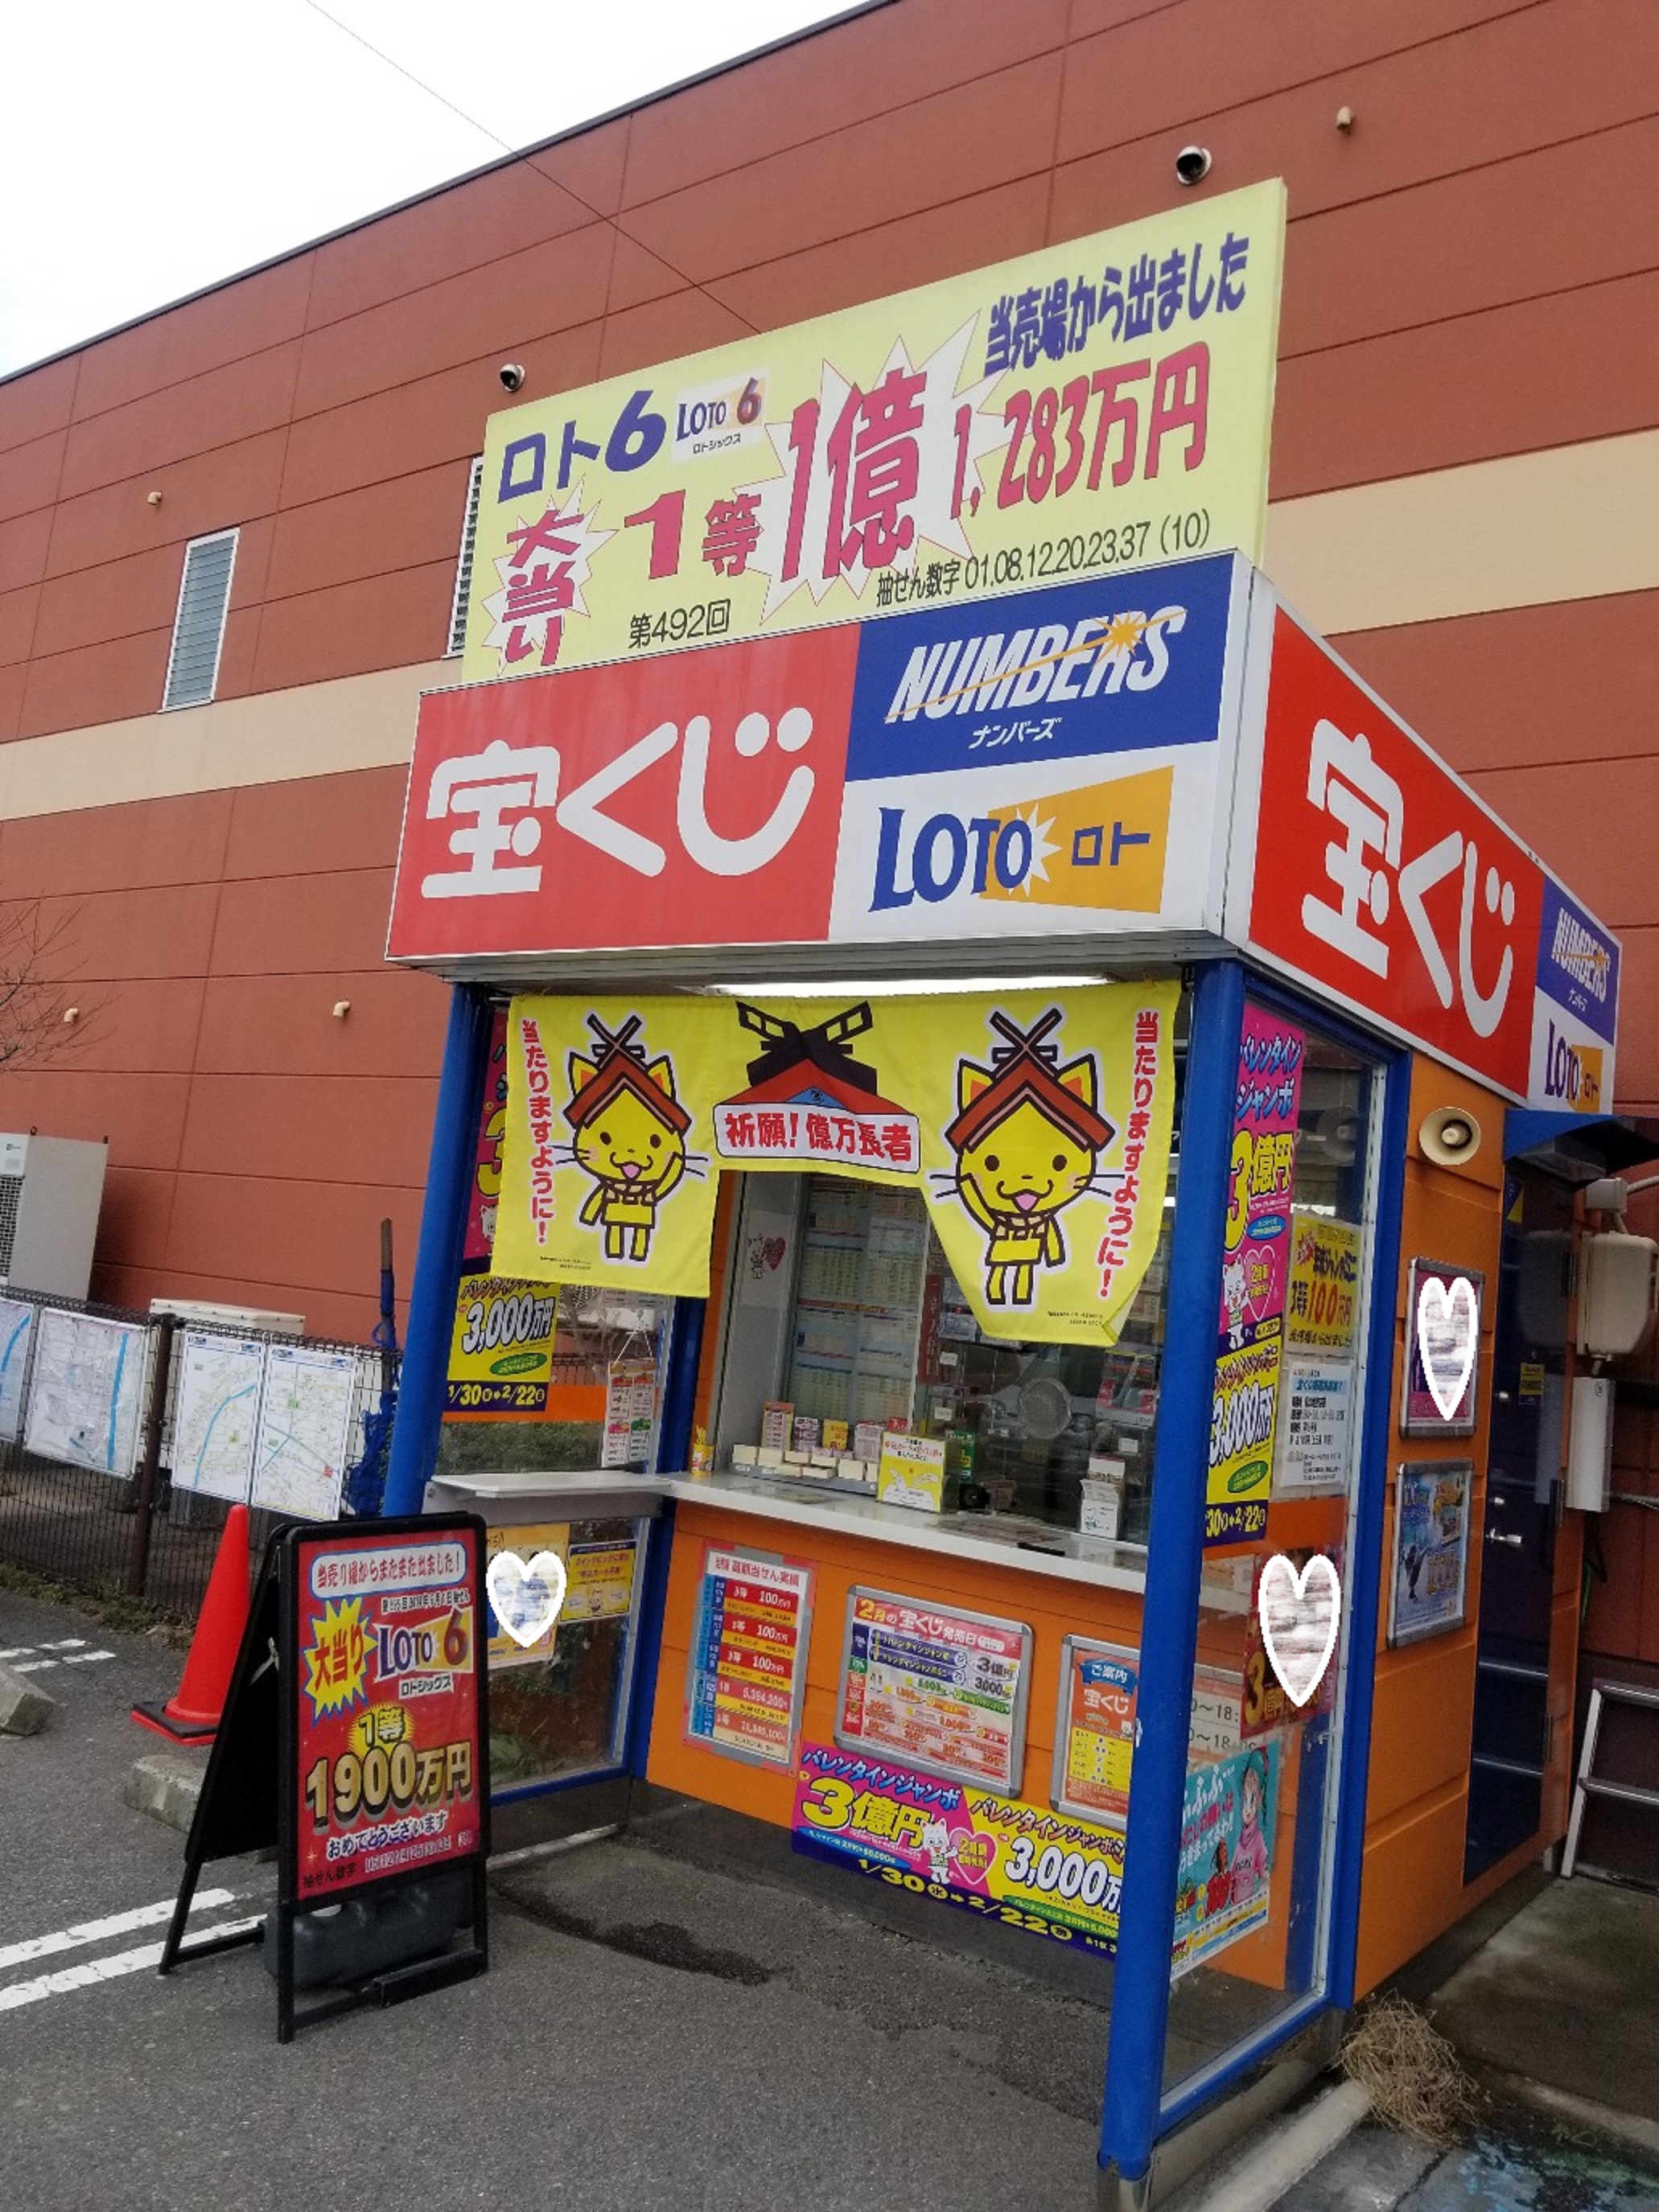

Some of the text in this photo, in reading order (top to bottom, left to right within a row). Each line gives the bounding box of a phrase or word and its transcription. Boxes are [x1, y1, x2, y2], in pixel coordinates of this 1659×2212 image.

[984, 232, 1249, 378] 当売場から出ました
[497, 389, 668, 504] ロト6
[693, 432, 742, 454] ロトシックス
[501, 508, 586, 667] 大当り
[875, 557, 961, 609] 抽せん数字
[628, 598, 731, 649] 第492回
[884, 605, 1188, 725] NUMBERS
[968, 717, 1062, 750] ナンバーズ
[421, 706, 815, 898] 宝くじ
[867, 807, 1151, 913] LOTO ロト
[1301, 717, 1516, 1038] 宝くじ
[1552, 907, 1611, 1003] NUMBERS
[1543, 1018, 1581, 1101] LOTO
[1237, 1077, 1295, 1122] ジャンボ
[1224, 1129, 1294, 1251] 3億円
[462, 1292, 555, 1355] 3,000万円
[315, 1623, 365, 1692] 大当り
[377, 1607, 468, 1680] LOTO 6
[1091, 1663, 1128, 1684] ご案内
[401, 1675, 452, 1697] ロトシックス
[1083, 1688, 1130, 1714] 宝くじ
[359, 1706, 405, 1748] 1等
[305, 1740, 472, 1828] 1900万円
[801, 1749, 961, 1811] バレンタインジャンボ
[801, 1777, 932, 1848] 3億円
[327, 1811, 448, 1860] おめでとうございます
